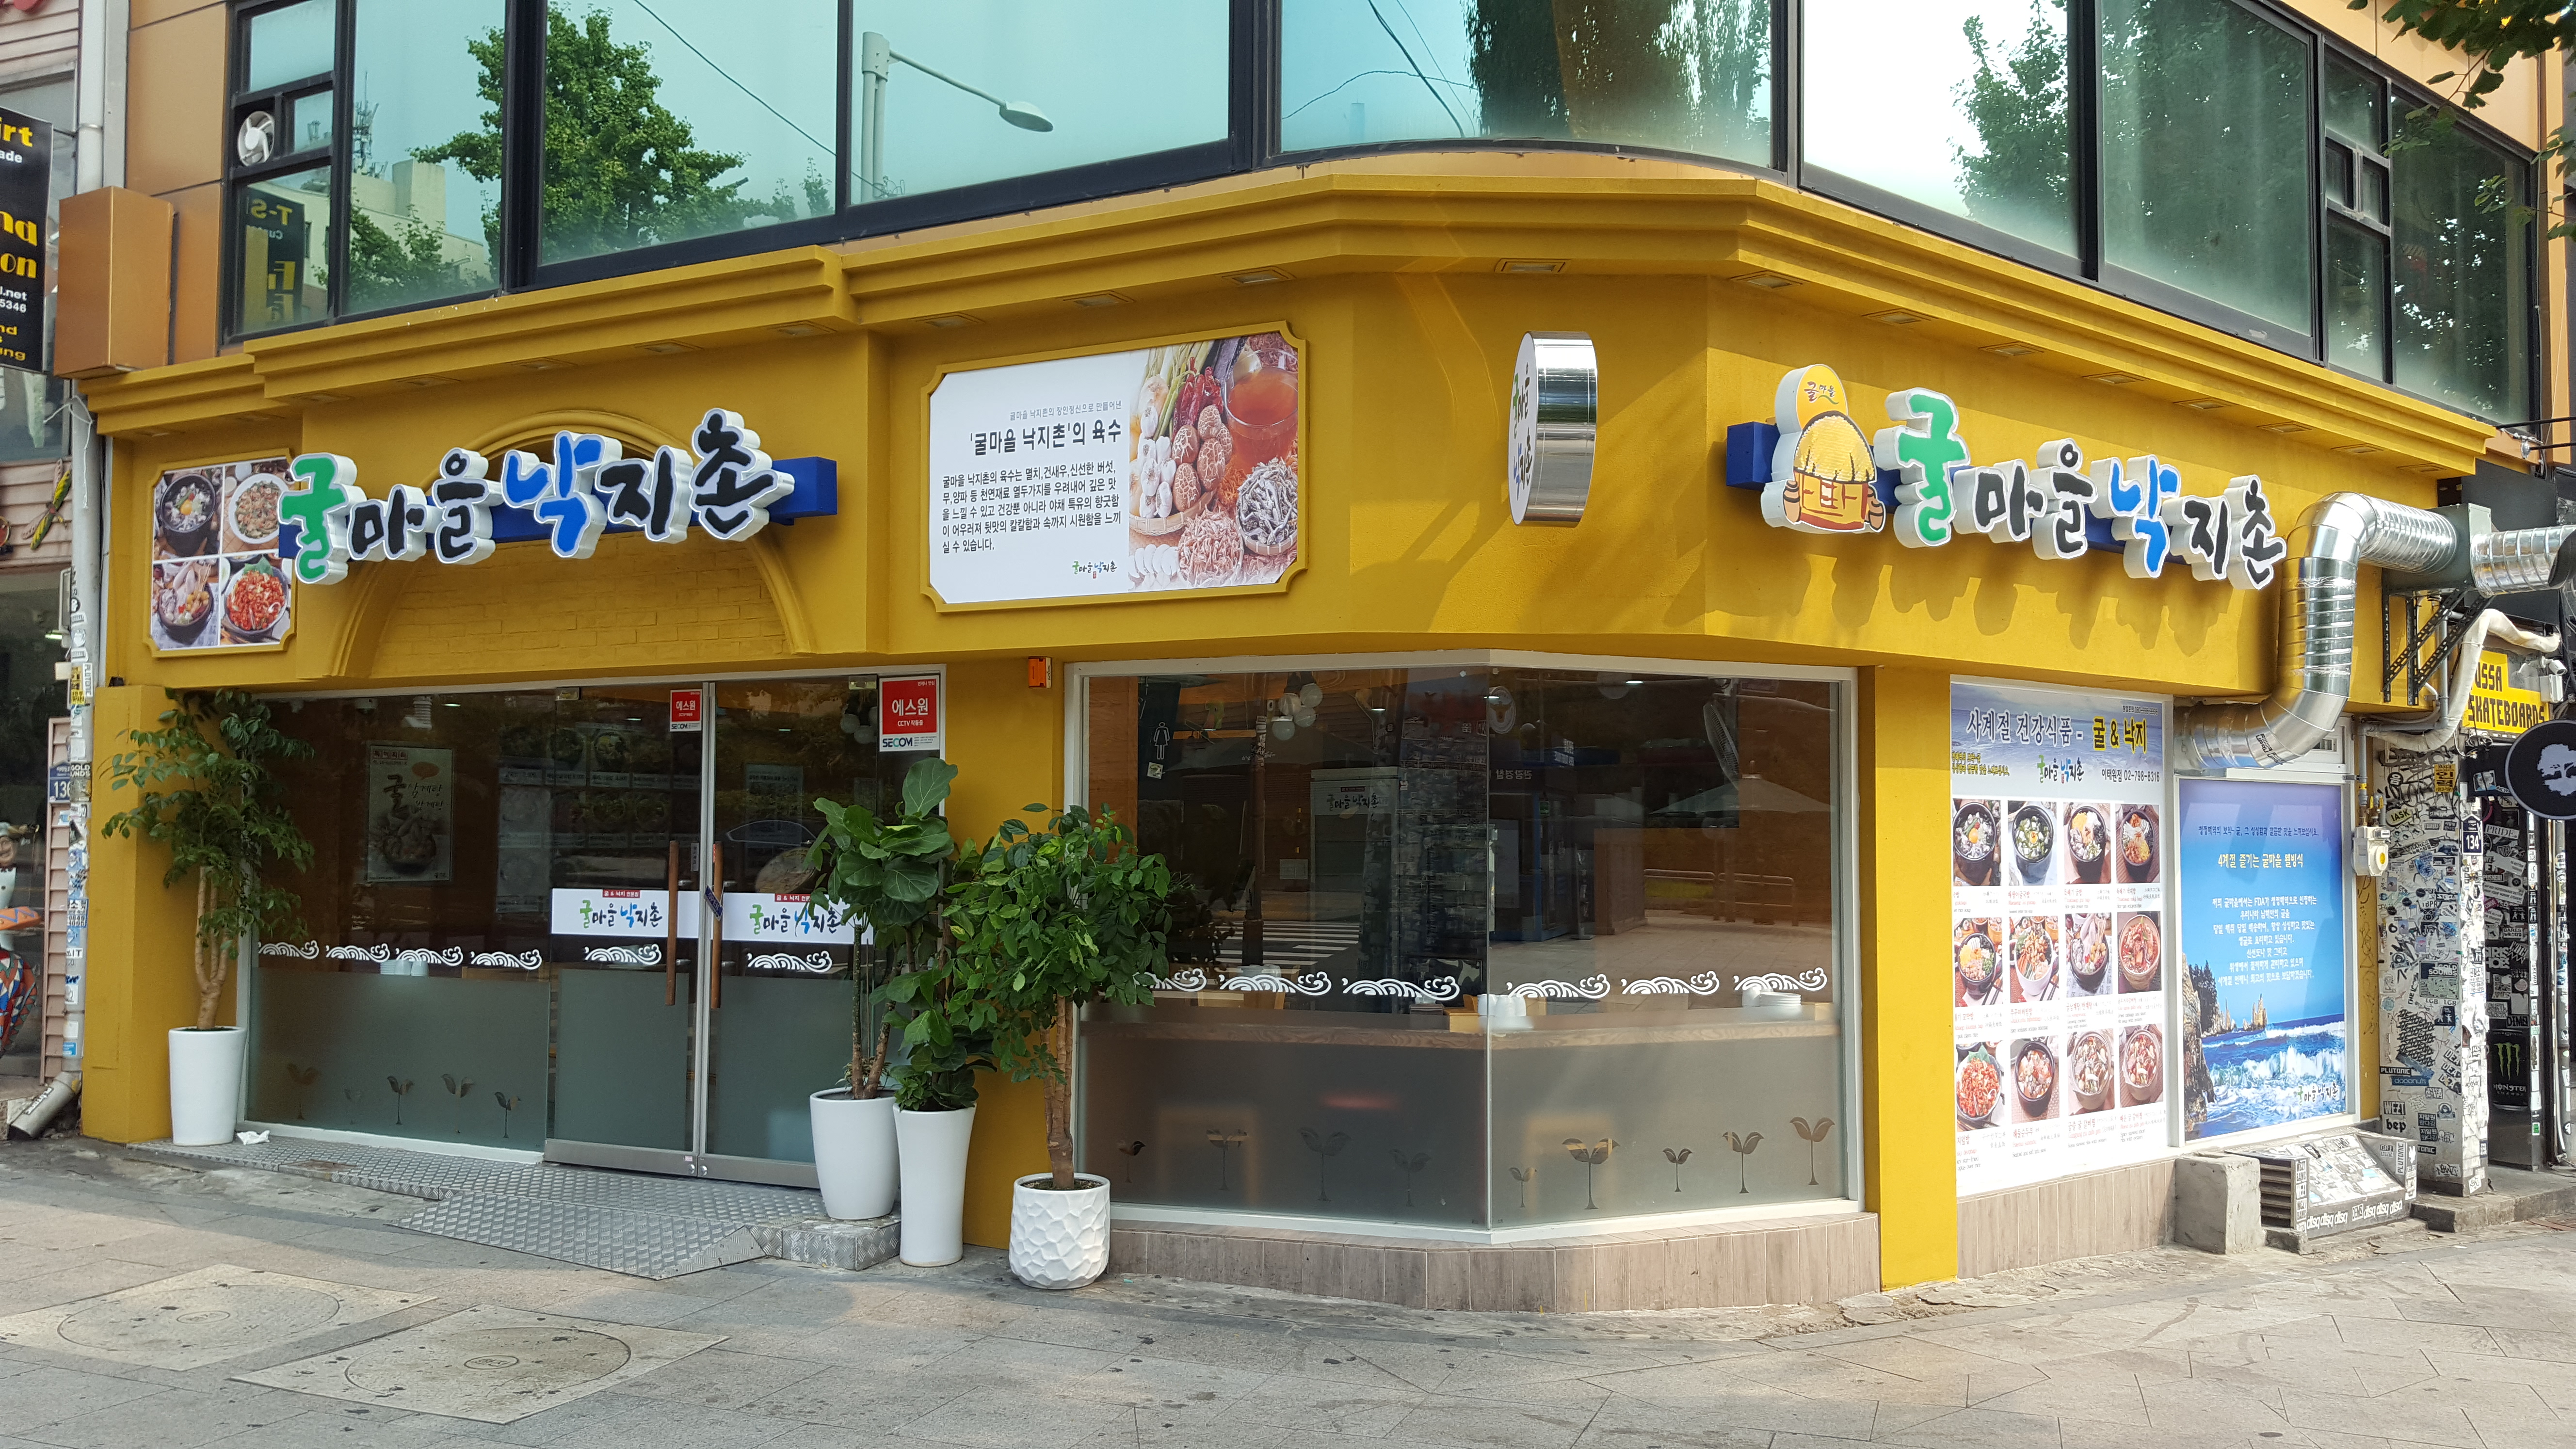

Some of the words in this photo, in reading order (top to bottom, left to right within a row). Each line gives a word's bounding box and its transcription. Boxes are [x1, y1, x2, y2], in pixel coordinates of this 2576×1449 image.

[1804, 381, 1835, 402] 굴마을
[1010, 411, 1028, 421] 굴마을
[1030, 408, 1055, 419] 낙지촌의
[1056, 403, 1094, 417] 장인정신으로
[1096, 400, 1122, 413] 만들어낸
[1092, 419, 1122, 443] 육수
[943, 474, 965, 488] 굴마을
[967, 470, 998, 486] 낙지촌의
[1000, 468, 1023, 483] 육수는
[1097, 460, 1116, 475] 버섯,
[969, 489, 978, 503] 등
[980, 486, 1010, 502] 천연재료
[1013, 482, 1051, 499] 열두가지를
[1054, 479, 1086, 496] 우려내어
[1089, 478, 1106, 492] 깊은
[1108, 477, 1116, 491] 맛
[942, 508, 950, 522] 을
[952, 506, 967, 521] 느낄
[969, 505, 978, 518] 수
[980, 503, 995, 518] 있고
[998, 501, 1021, 517] 건강뿐
[1023, 499, 1047, 515] 아니라
[1049, 497, 1065, 512] 야채
[1067, 495, 1093, 511] 특유의
[1095, 493, 1120, 509] 향긋함
[942, 524, 950, 537] 이
[952, 520, 982, 536] 어우러져
[984, 518, 1007, 534] 뒷맛의
[1010, 516, 1041, 532] 칼칼함과
[1043, 514, 1067, 530] 속까지
[1069, 512, 1102, 528] 시원함을
[1105, 510, 1122, 525] 느끼
[942, 540, 950, 554] 실
[952, 539, 961, 553] 수
[963, 537, 995, 553] 있습니다.
[676, 700, 696, 711] 에스원
[891, 698, 929, 716] 에스원
[2467, 694, 2545, 729] SKATEBOARDS
[1967, 707, 2011, 742] 사계절
[2017, 712, 2072, 746] 건강식품
[2093, 716, 2106, 751] 굴
[2109, 719, 2120, 748] &
[2123, 717, 2148, 754] 낙지
[883, 737, 913, 748] SECOM
[2101, 769, 2122, 783] 이태원점
[2124, 770, 2160, 782] 02-798-8316
[2465, 835, 2479, 850] 134
[2218, 853, 2237, 869] 4계절
[2239, 853, 2259, 869] 즐기는
[2262, 853, 2282, 869] 굴마을
[2284, 853, 2304, 868] 웰빙식
[707, 892, 720, 910] OPEN
[2254, 896, 2270, 907] FDA가
[2493, 1083, 2527, 1092] MONSTER
